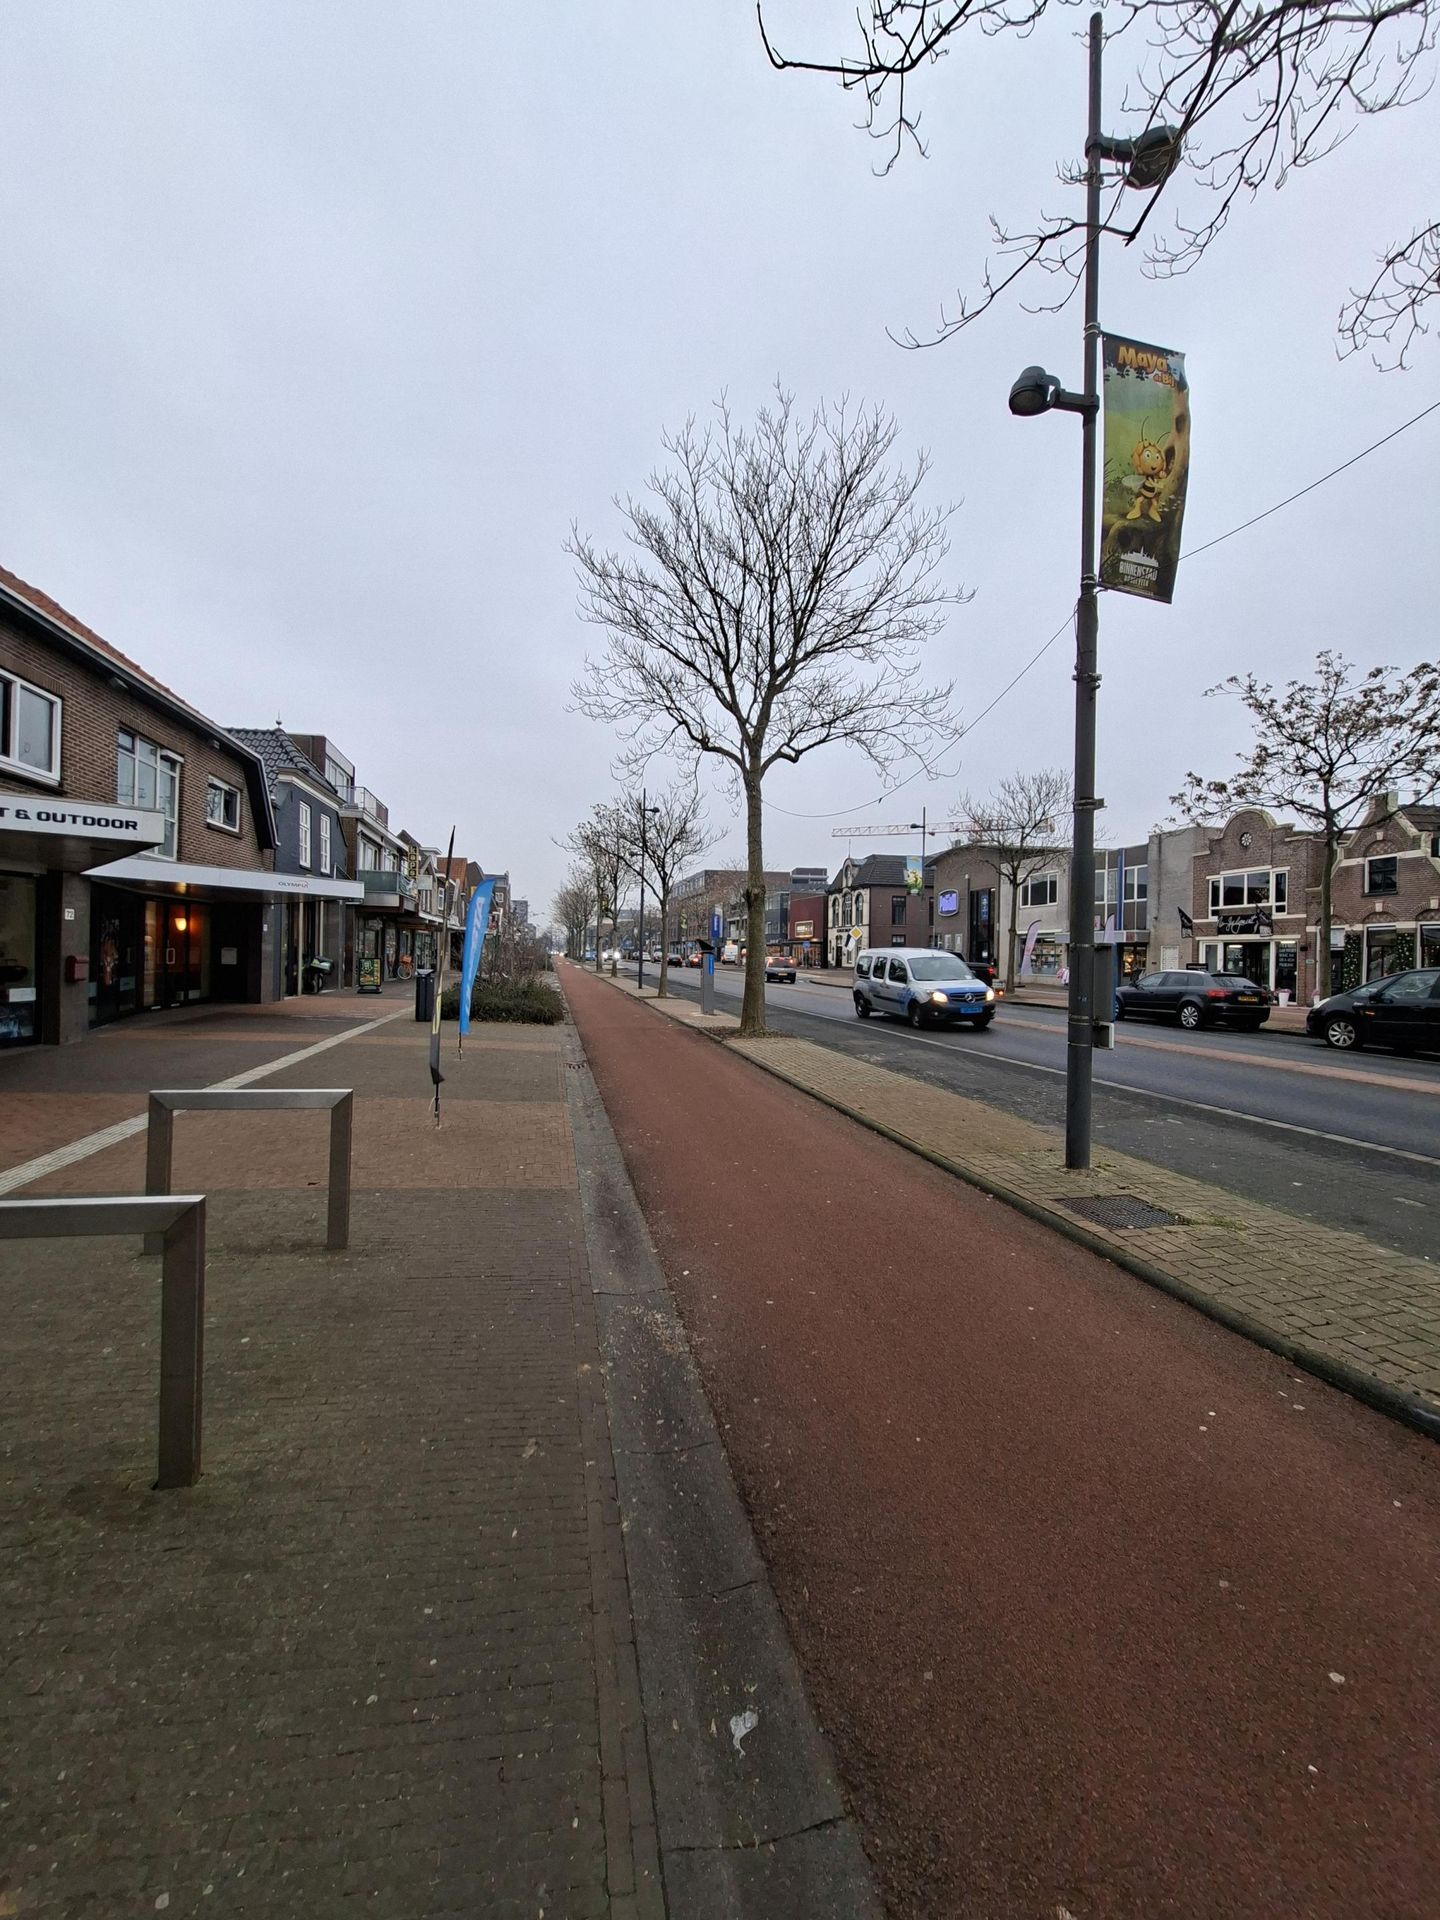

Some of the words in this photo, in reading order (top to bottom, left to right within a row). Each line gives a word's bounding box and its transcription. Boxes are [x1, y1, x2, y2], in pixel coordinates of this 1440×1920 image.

[1118, 346, 1168, 374] Maya
[1119, 561, 1158, 581] BINNENSTAD
[15, 808, 32, 820] &
[36, 811, 138, 830] OUTDOOR
[66, 910, 73, 919] 72
